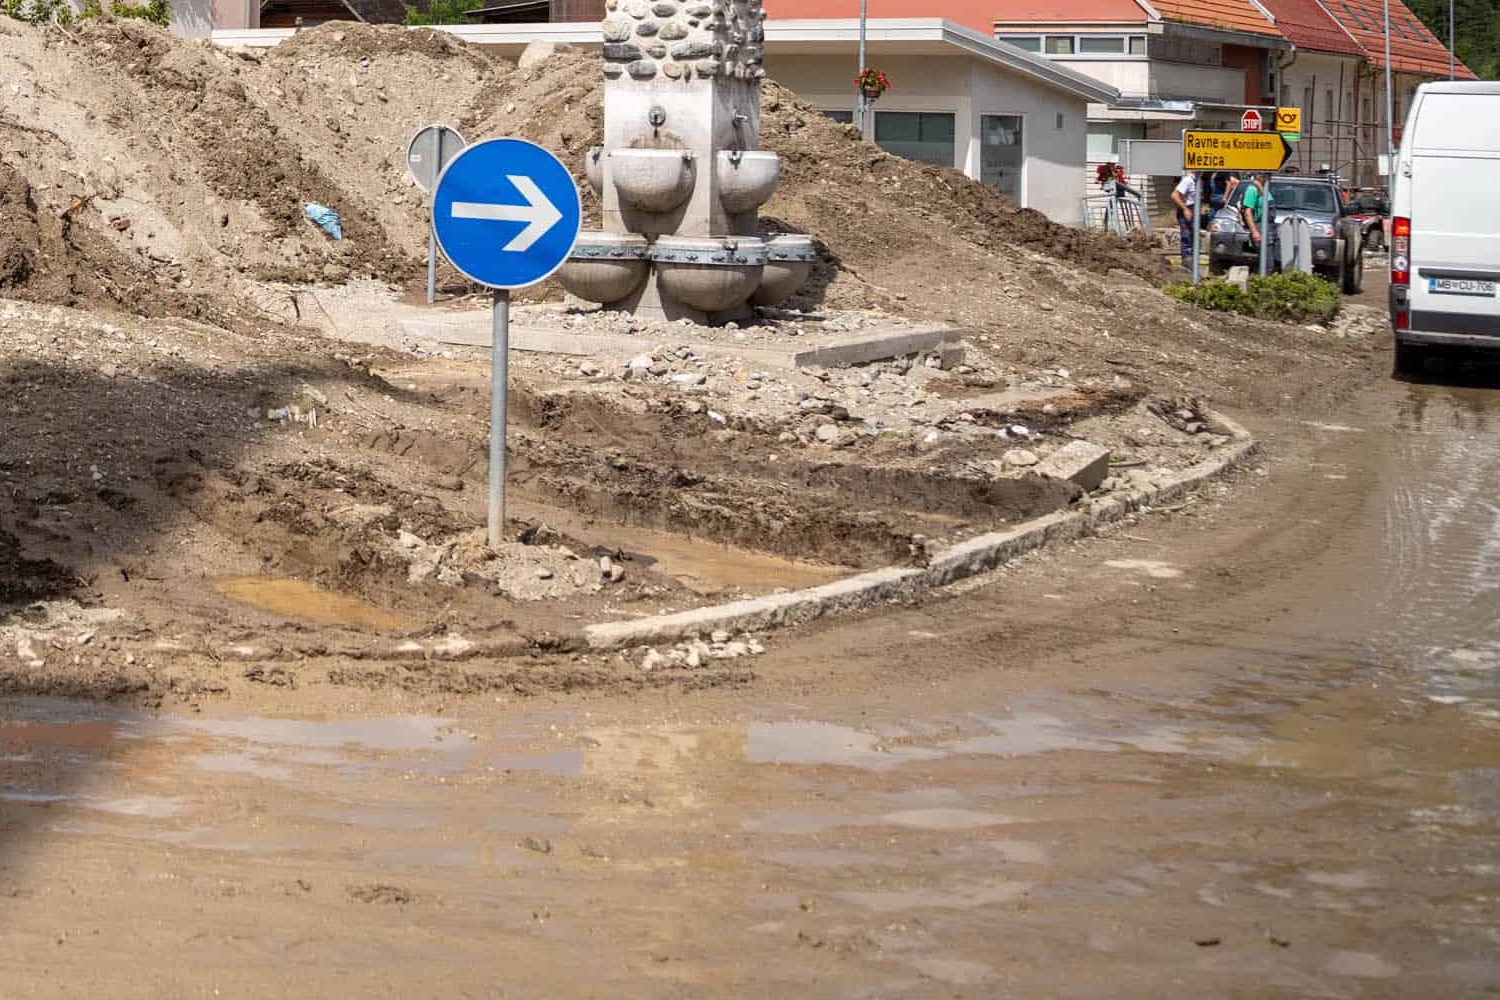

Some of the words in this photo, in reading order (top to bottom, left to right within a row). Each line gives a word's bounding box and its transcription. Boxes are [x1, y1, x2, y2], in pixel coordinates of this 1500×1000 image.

[1187, 133, 1219, 149] Ravne
[1220, 140, 1231, 149] na
[1233, 138, 1273, 150] Koroškem
[1187, 151, 1225, 167] Mežica
